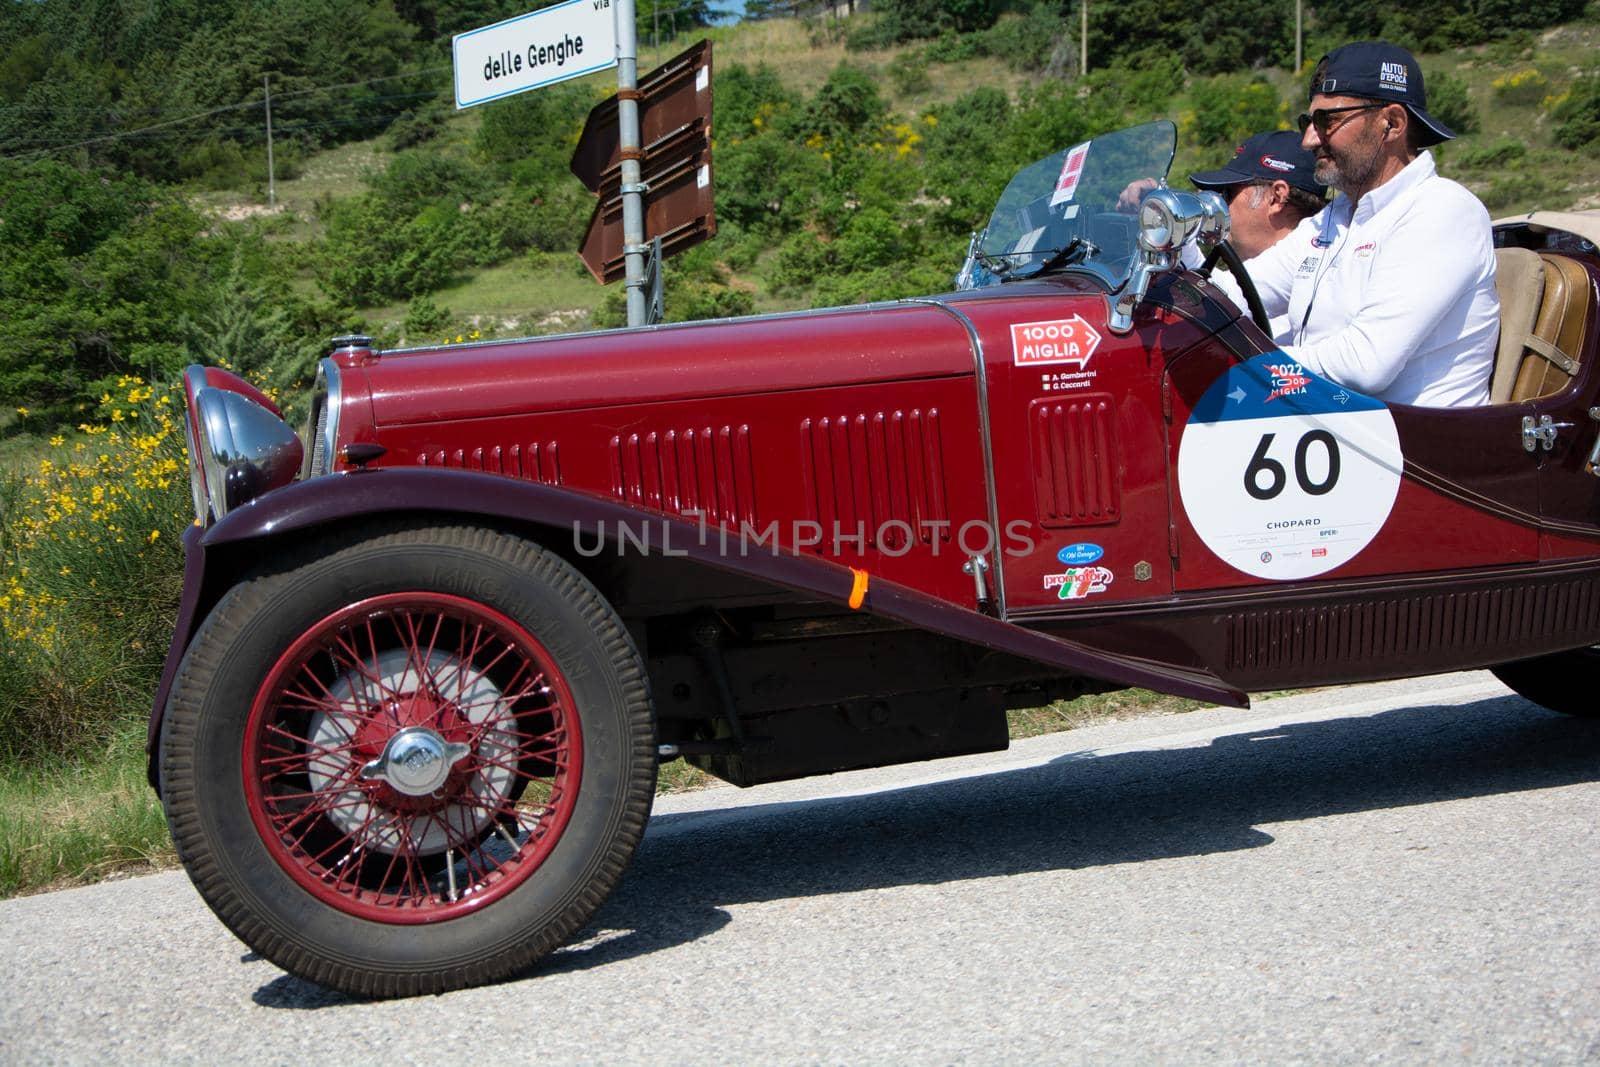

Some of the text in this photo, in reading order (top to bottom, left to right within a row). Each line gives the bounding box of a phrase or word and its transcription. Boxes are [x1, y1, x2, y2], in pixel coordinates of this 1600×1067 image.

[593, 0, 610, 10] via
[484, 34, 584, 81] delle Genghe
[1380, 62, 1403, 75] AUTO
[1380, 73, 1407, 84] D'EPOCA
[1023, 325, 1074, 341] 1000
[1022, 342, 1080, 359] MIGLIA
[1271, 364, 1304, 377] 2022
[1271, 386, 1308, 396] MIGLIA
[1244, 429, 1341, 500] 60
[1266, 518, 1321, 530] CHOPARD
[1044, 568, 1103, 588] promotor
